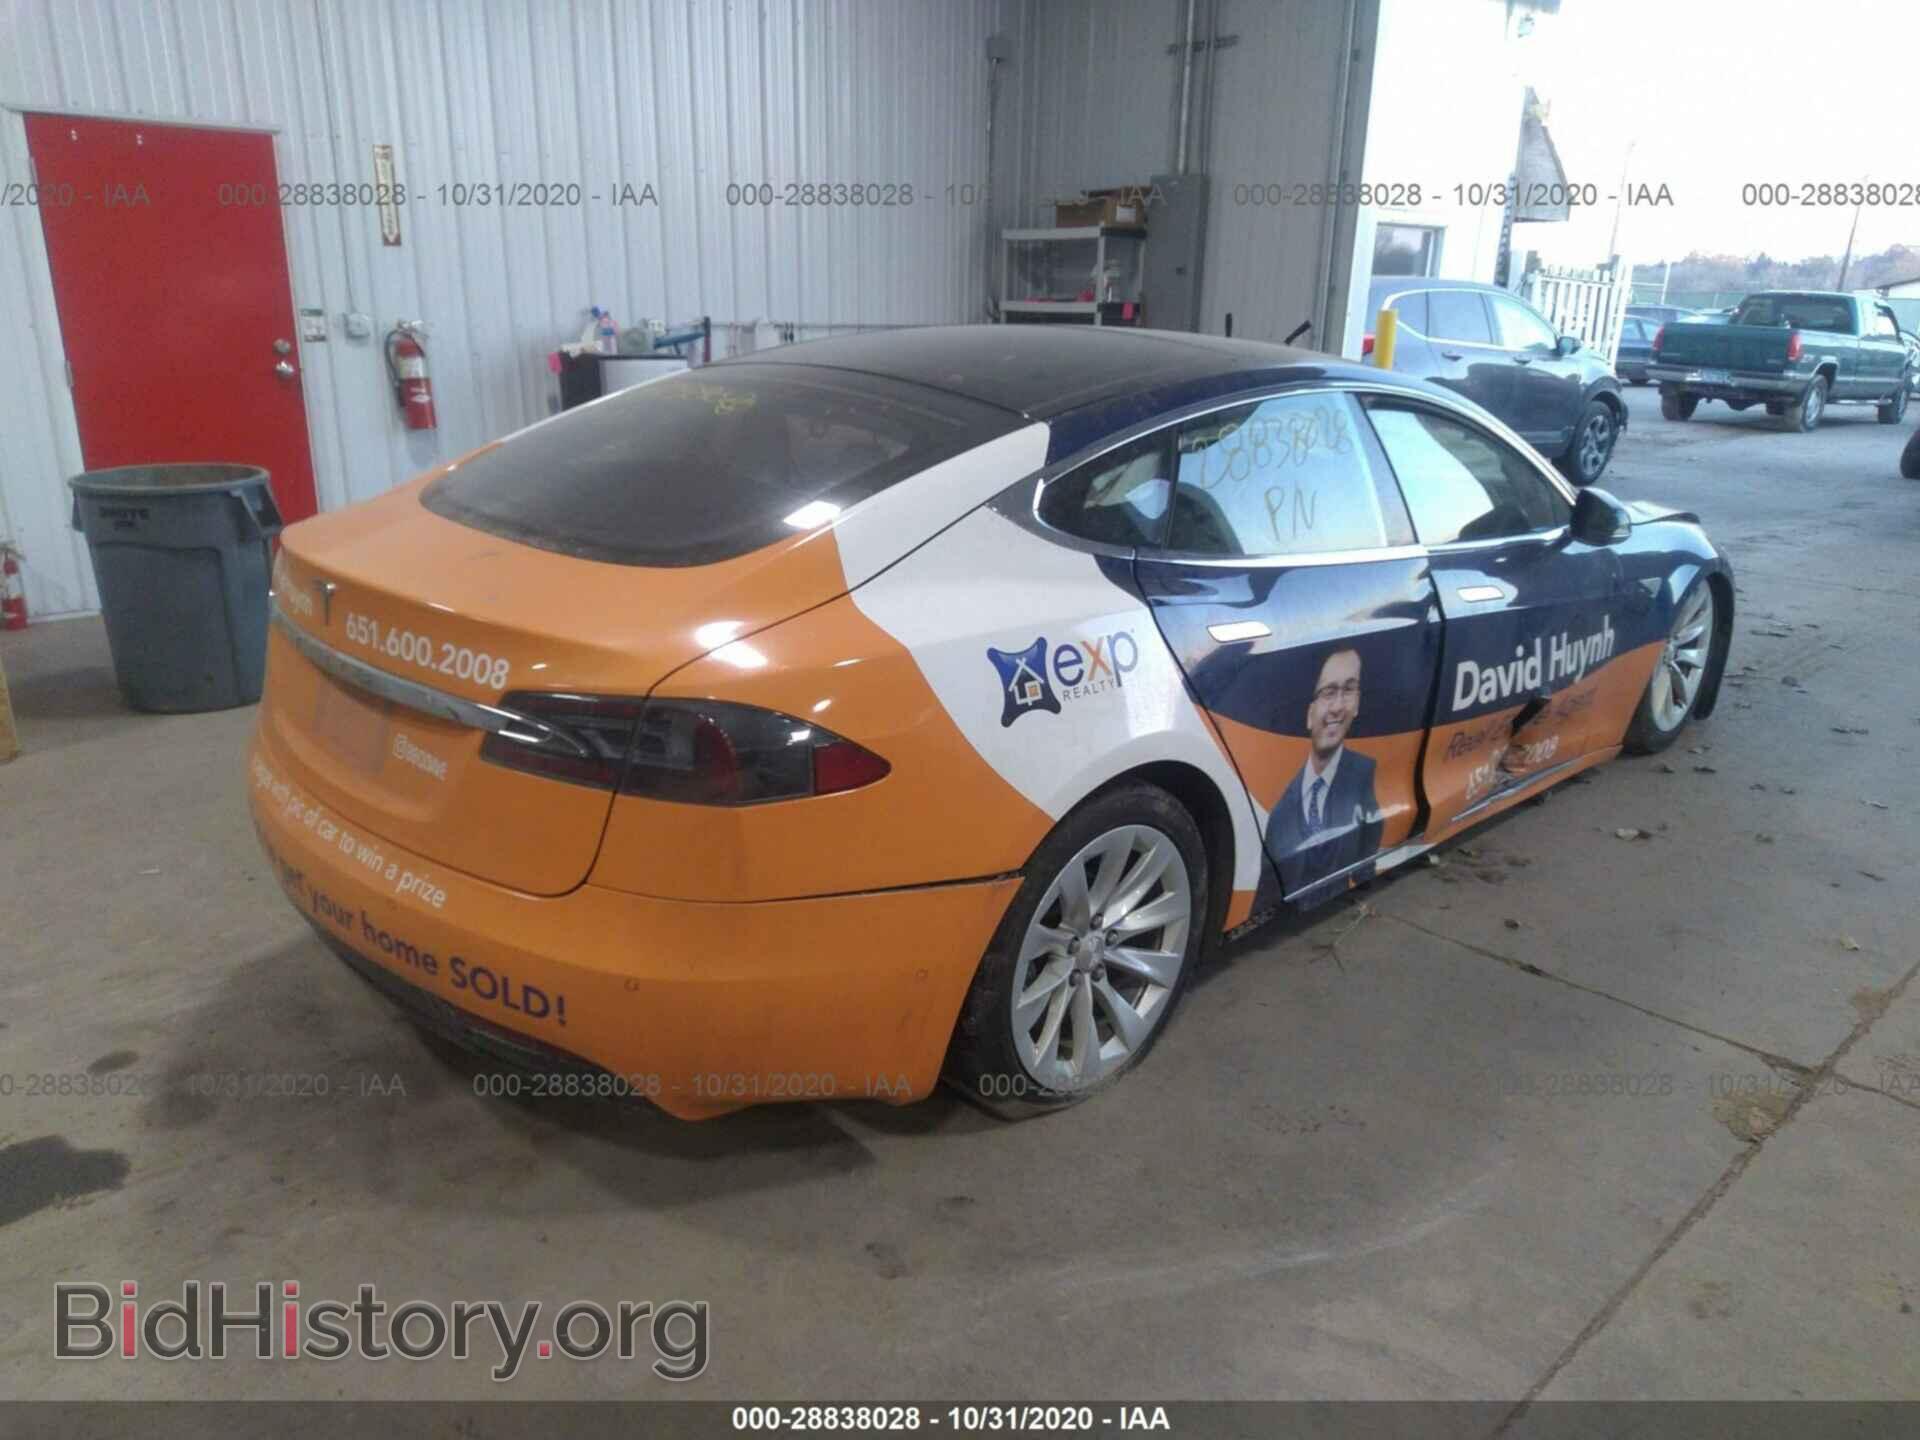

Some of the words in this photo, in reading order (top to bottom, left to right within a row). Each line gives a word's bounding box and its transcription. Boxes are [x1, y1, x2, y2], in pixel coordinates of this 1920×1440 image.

[1264, 482, 1318, 542] PN
[346, 611, 509, 690] 651.600.2008
[1452, 637, 1542, 712] David
[1549, 614, 1615, 683] Huynh
[1063, 680, 1115, 702] REALTY
[339, 832, 355, 854] to
[356, 845, 383, 873] win
[385, 864, 398, 881] a
[397, 868, 448, 909] prize
[361, 911, 438, 976] home
[450, 957, 567, 1026] SOLD!
